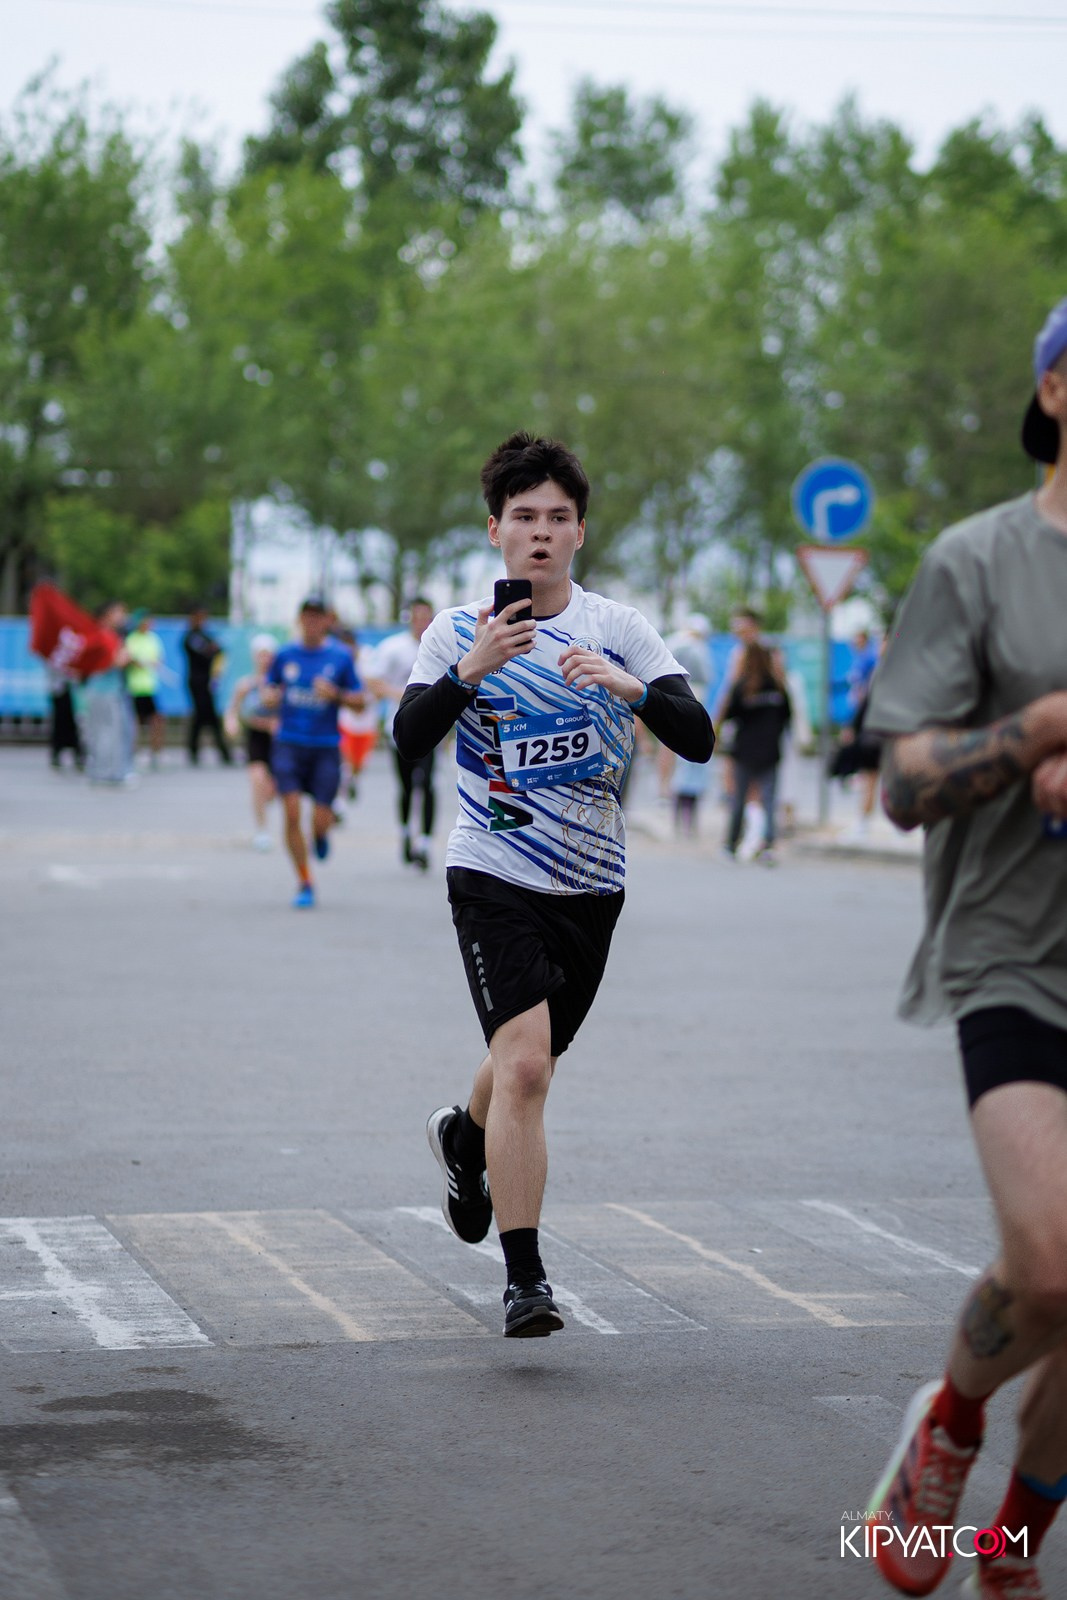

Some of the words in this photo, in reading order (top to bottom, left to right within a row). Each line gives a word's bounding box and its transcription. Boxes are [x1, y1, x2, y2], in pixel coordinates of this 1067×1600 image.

[564, 716, 584, 724] GROUP
[503, 724, 510, 732] 5
[513, 723, 527, 732] KM
[516, 732, 589, 768] 1259
